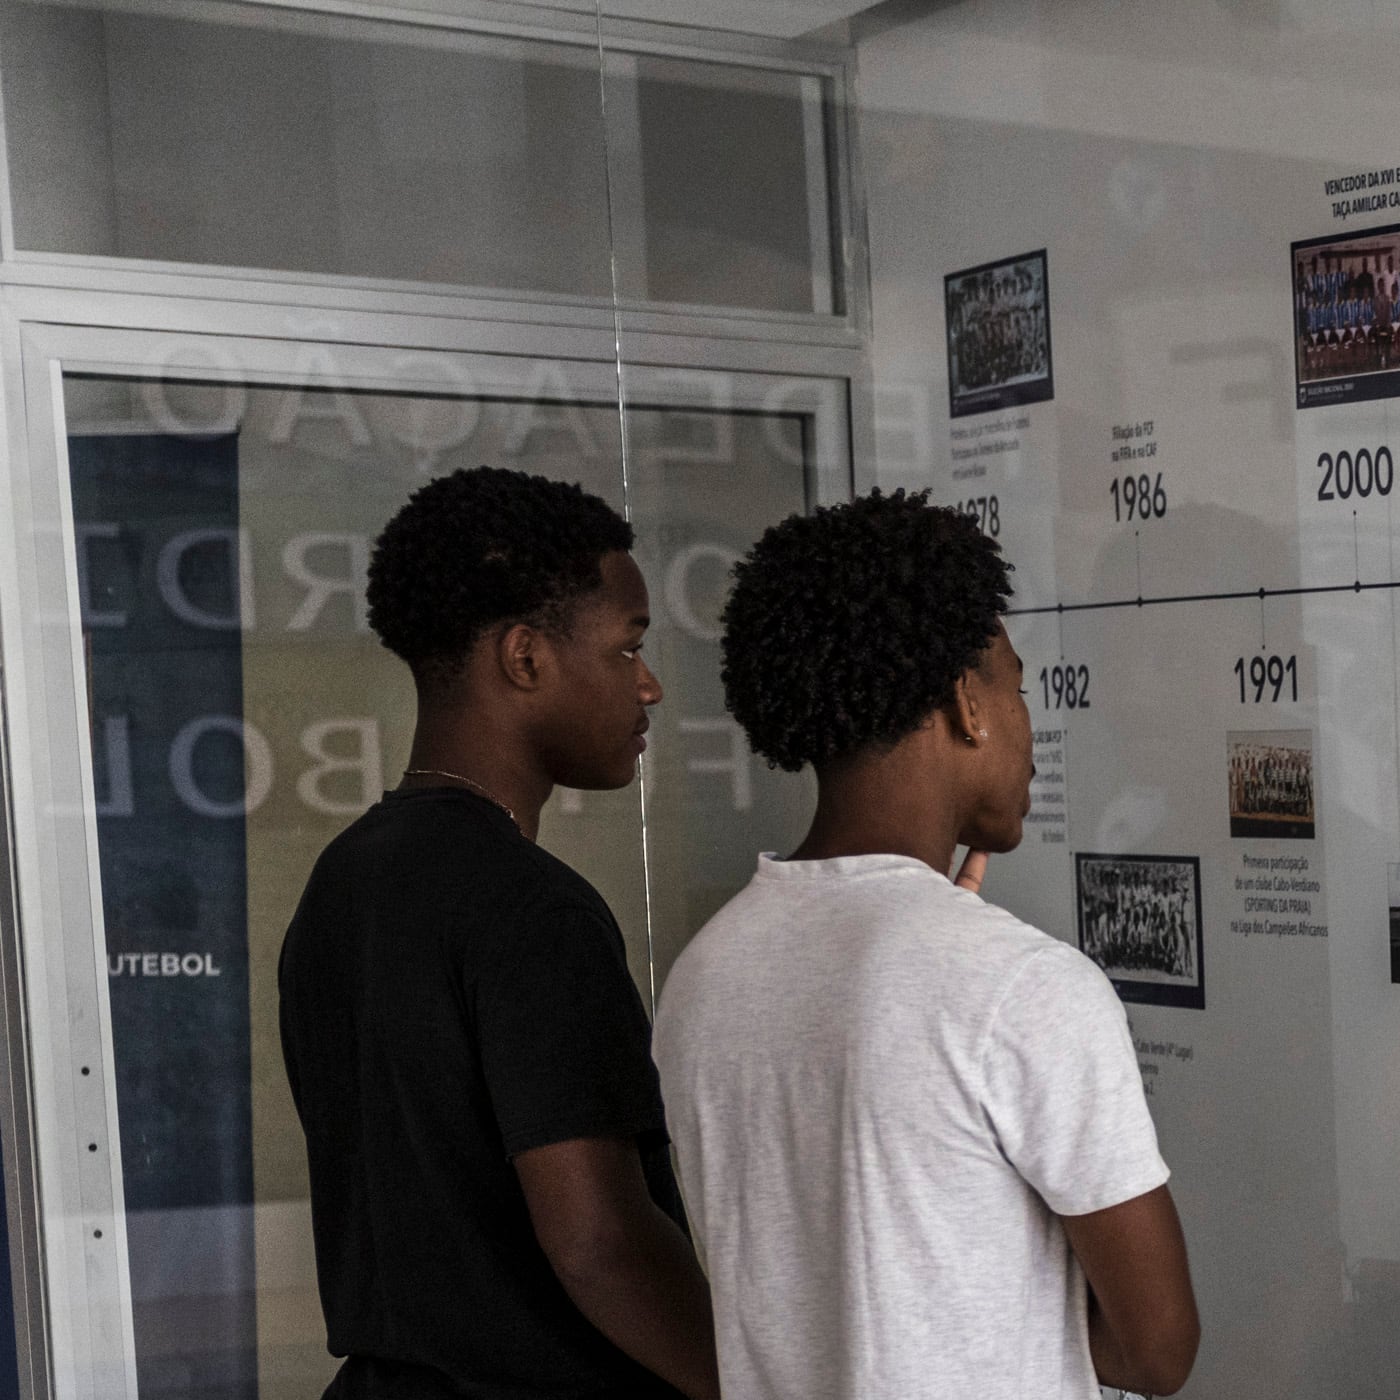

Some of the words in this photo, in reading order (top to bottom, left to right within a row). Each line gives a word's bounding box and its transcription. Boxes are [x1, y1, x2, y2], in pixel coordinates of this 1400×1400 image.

[1324, 173, 1367, 196] VENCEDOR
[1367, 171, 1380, 188] DA
[1379, 168, 1395, 186] XVI
[1351, 193, 1388, 214] AMILCAR
[1317, 445, 1394, 501] 2000
[1109, 471, 1167, 523] 1986
[1039, 663, 1090, 710] 1982
[1233, 654, 1297, 704] 1991
[108, 952, 220, 976] UTEBOL
